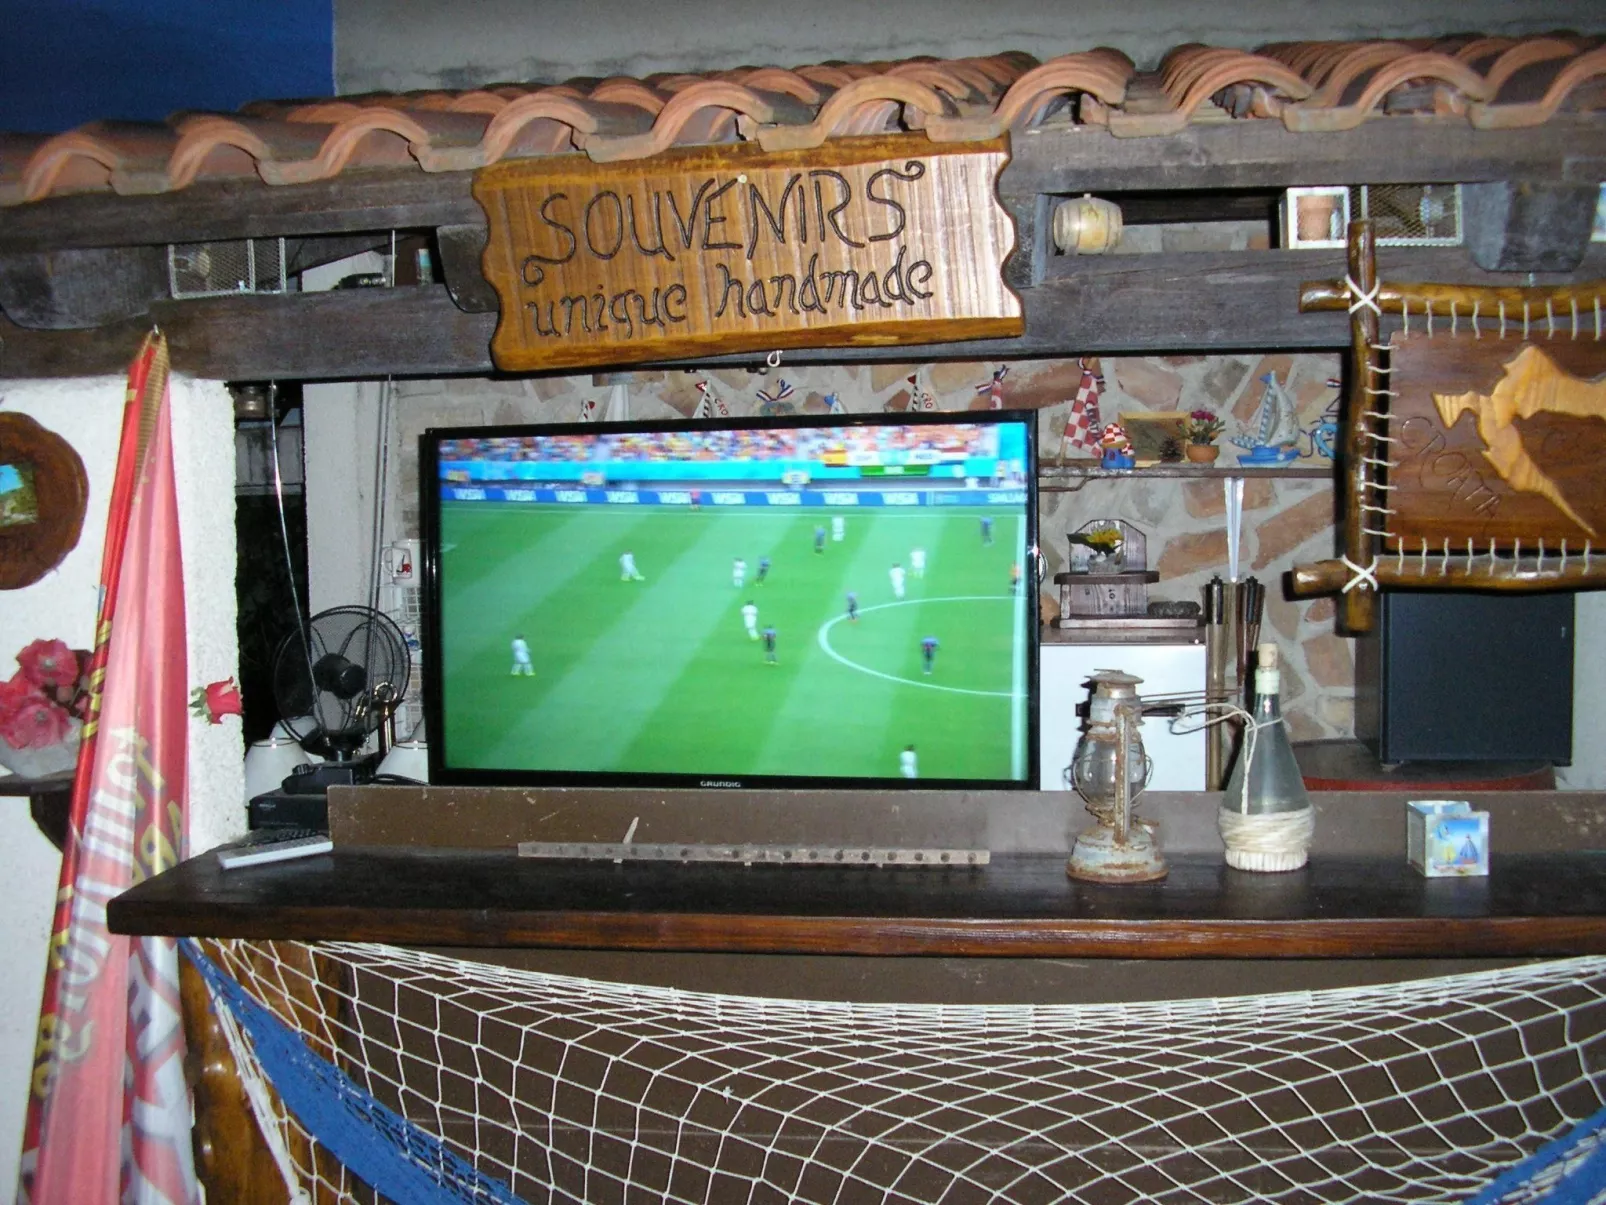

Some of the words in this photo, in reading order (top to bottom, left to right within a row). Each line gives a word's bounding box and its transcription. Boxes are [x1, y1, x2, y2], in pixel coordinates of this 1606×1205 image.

[521, 161, 926, 287] SOUVENIRS
[525, 284, 688, 339] unique
[714, 245, 934, 320] handmade
[699, 780, 741, 788] GRUNDIG
